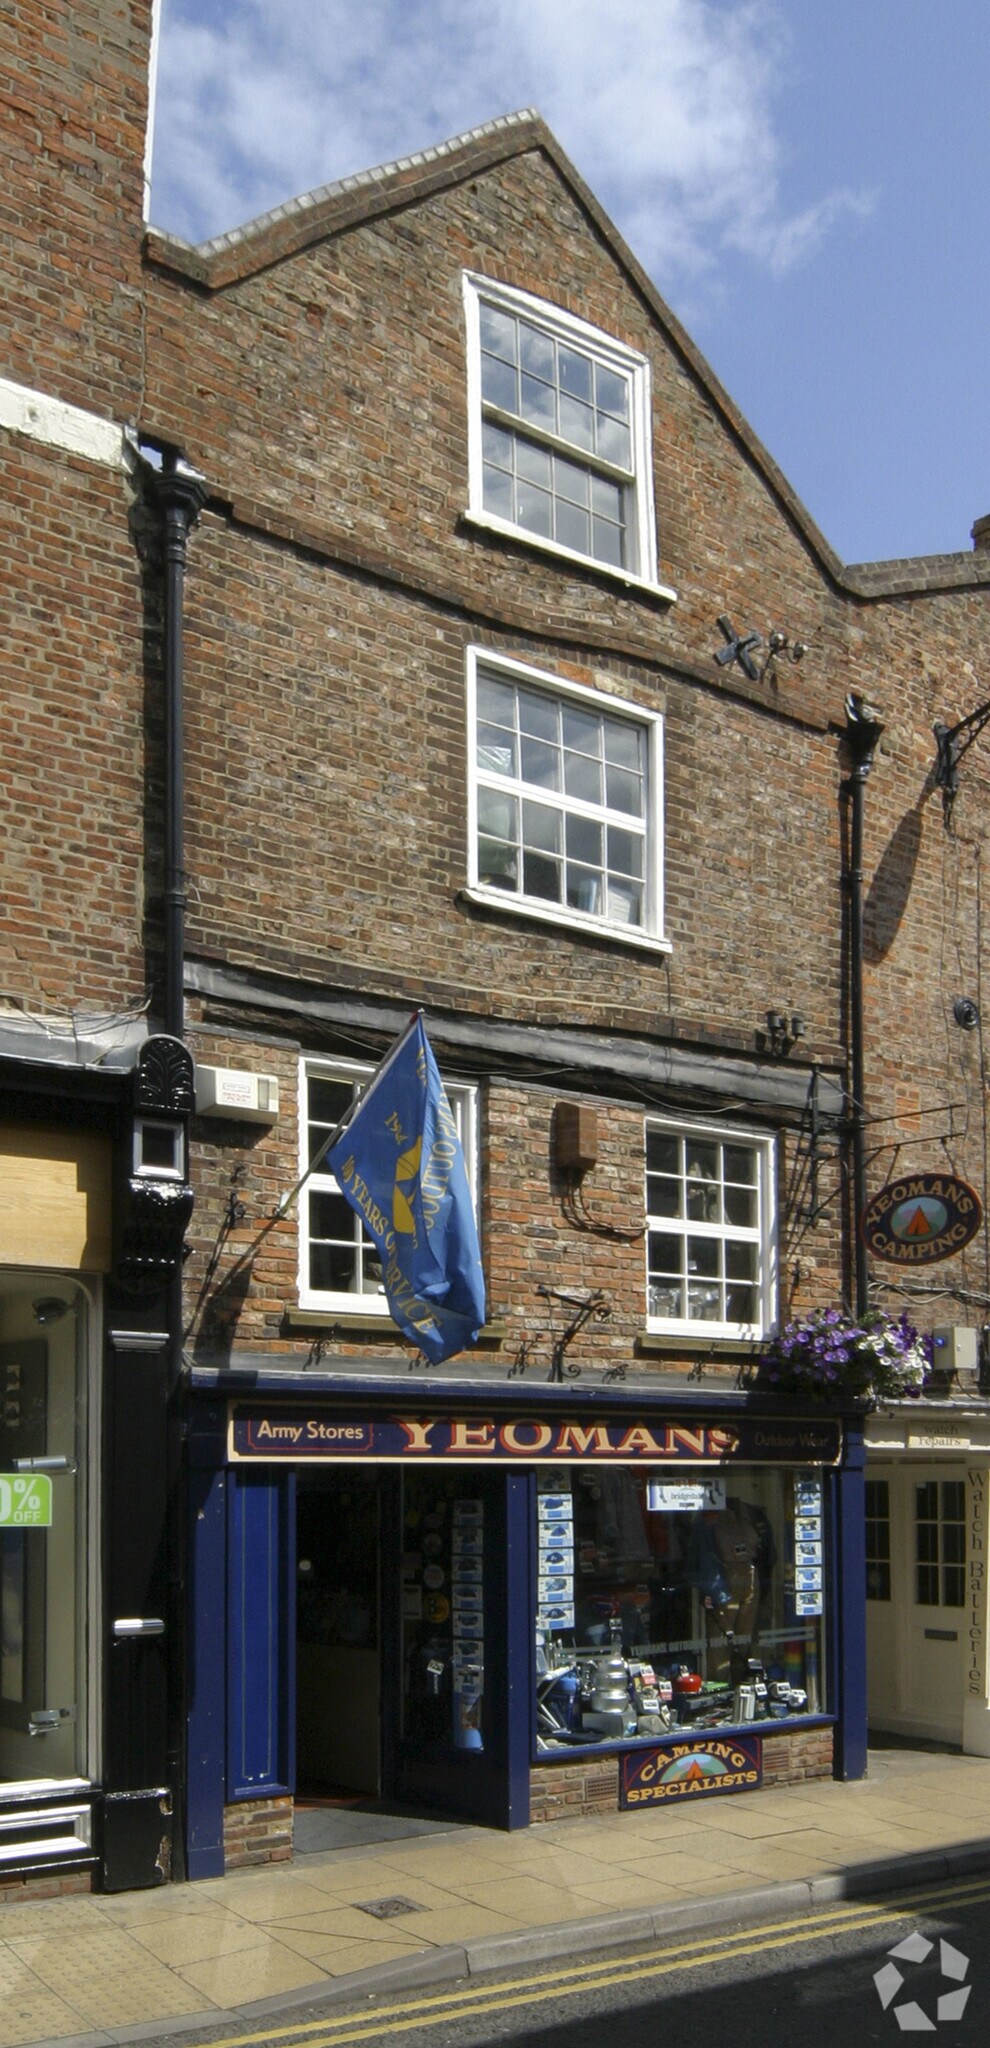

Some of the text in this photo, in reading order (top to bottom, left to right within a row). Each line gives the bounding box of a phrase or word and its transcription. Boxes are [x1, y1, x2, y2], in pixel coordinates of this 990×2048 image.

[350, 1173, 390, 1236] YEARS
[866, 1180, 975, 1227] YEOMANS
[871, 1223, 968, 1259] CAMPING
[257, 1415, 829, 1455] Army Stores YEOMANS Outdoor Wear
[919, 1435, 962, 1448] repairs
[923, 1424, 959, 1436] watch
[13, 1510, 42, 1523] OFF
[967, 1471, 986, 1695] Watch Batteries
[640, 1742, 746, 1782] CAMPING
[626, 1770, 758, 1803] SPECIALISTS
